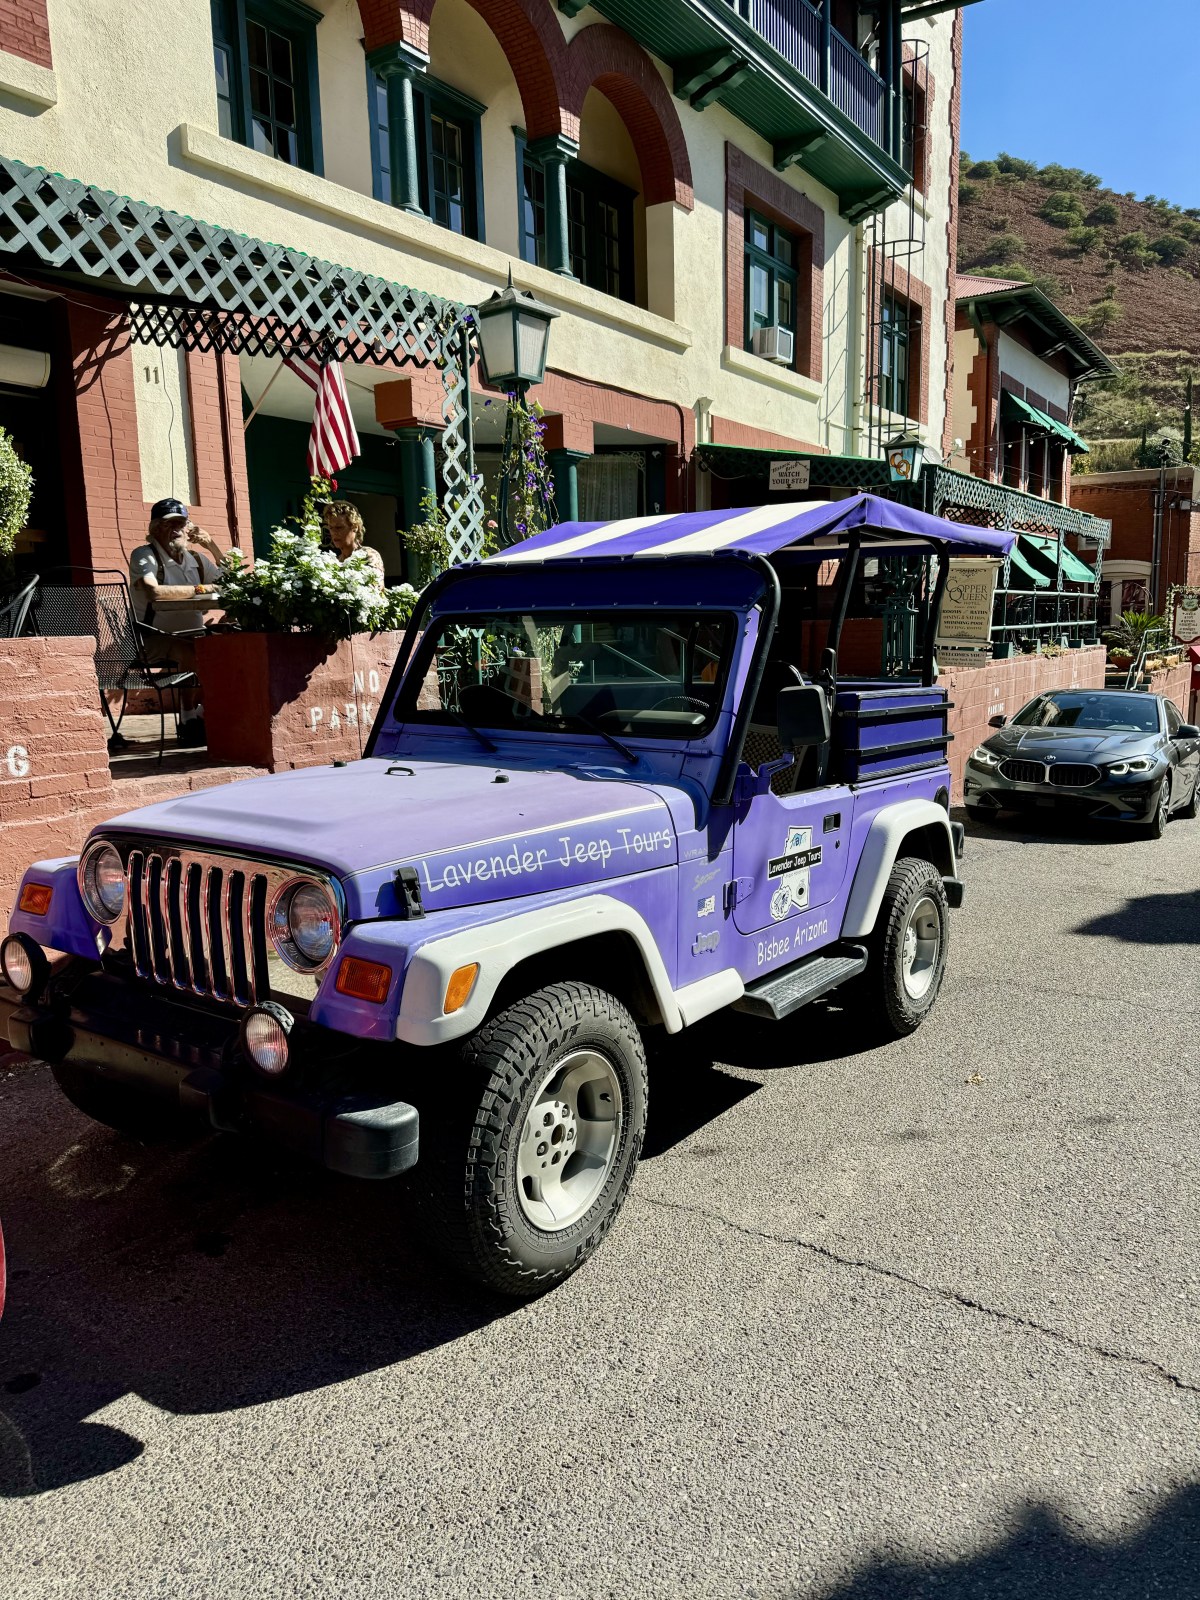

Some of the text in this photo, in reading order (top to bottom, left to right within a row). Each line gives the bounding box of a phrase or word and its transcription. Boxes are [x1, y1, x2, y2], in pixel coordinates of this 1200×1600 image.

[143, 365, 160, 384] 11
[945, 579, 988, 593] COPPER
[948, 587, 988, 604] QUEEN
[352, 669, 380, 694] NO
[310, 701, 376, 732] PARK
[987, 702, 1004, 716] PARKING
[422, 828, 673, 893] Lavender Jeep Tours
[768, 859, 793, 875] Lavender
[794, 855, 807, 868] Jeep
[807, 851, 822, 862] Tours
[757, 919, 828, 966] Bisbee Arizona
